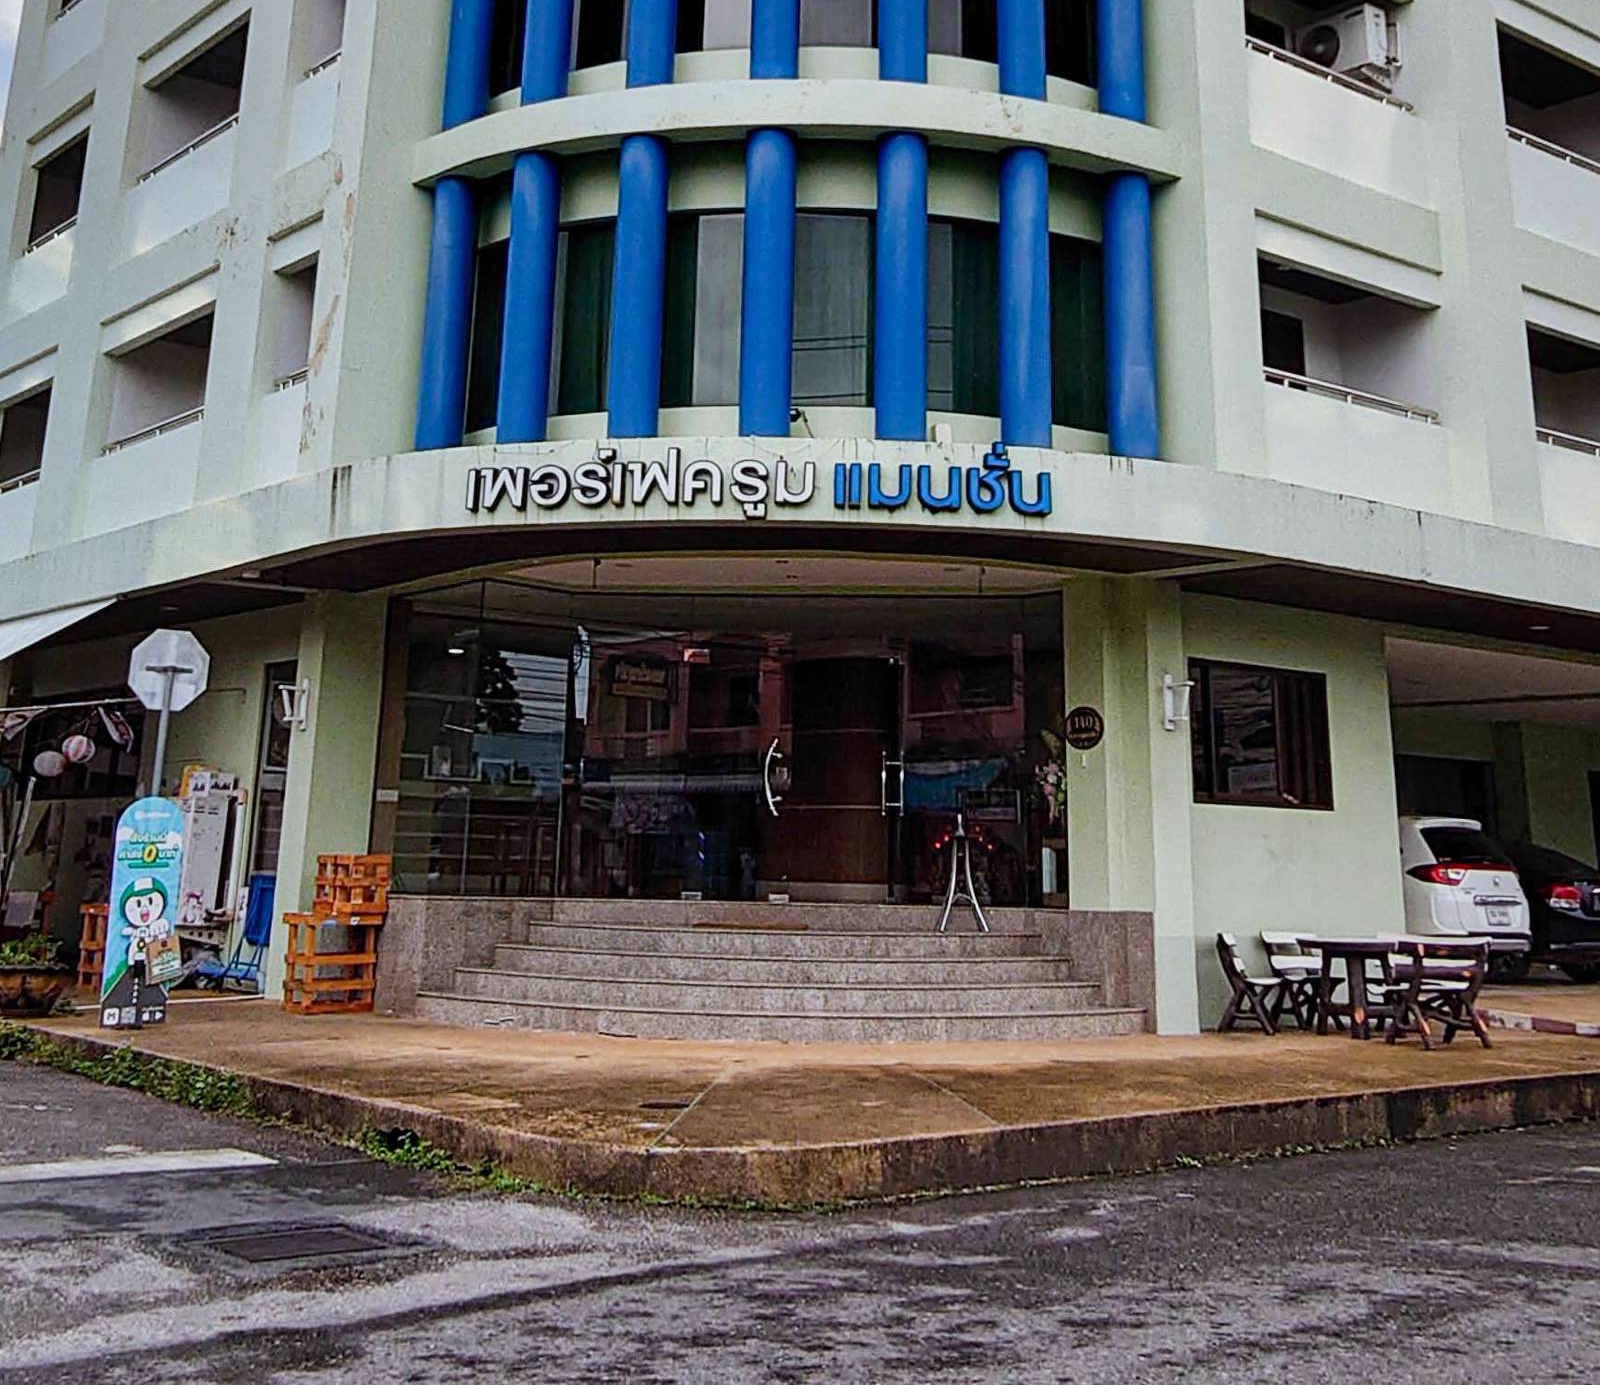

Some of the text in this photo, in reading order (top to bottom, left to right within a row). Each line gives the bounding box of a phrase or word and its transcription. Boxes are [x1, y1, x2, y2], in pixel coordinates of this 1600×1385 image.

[465, 441, 1052, 520] เพอร์เฟครูม แมนชั่น
